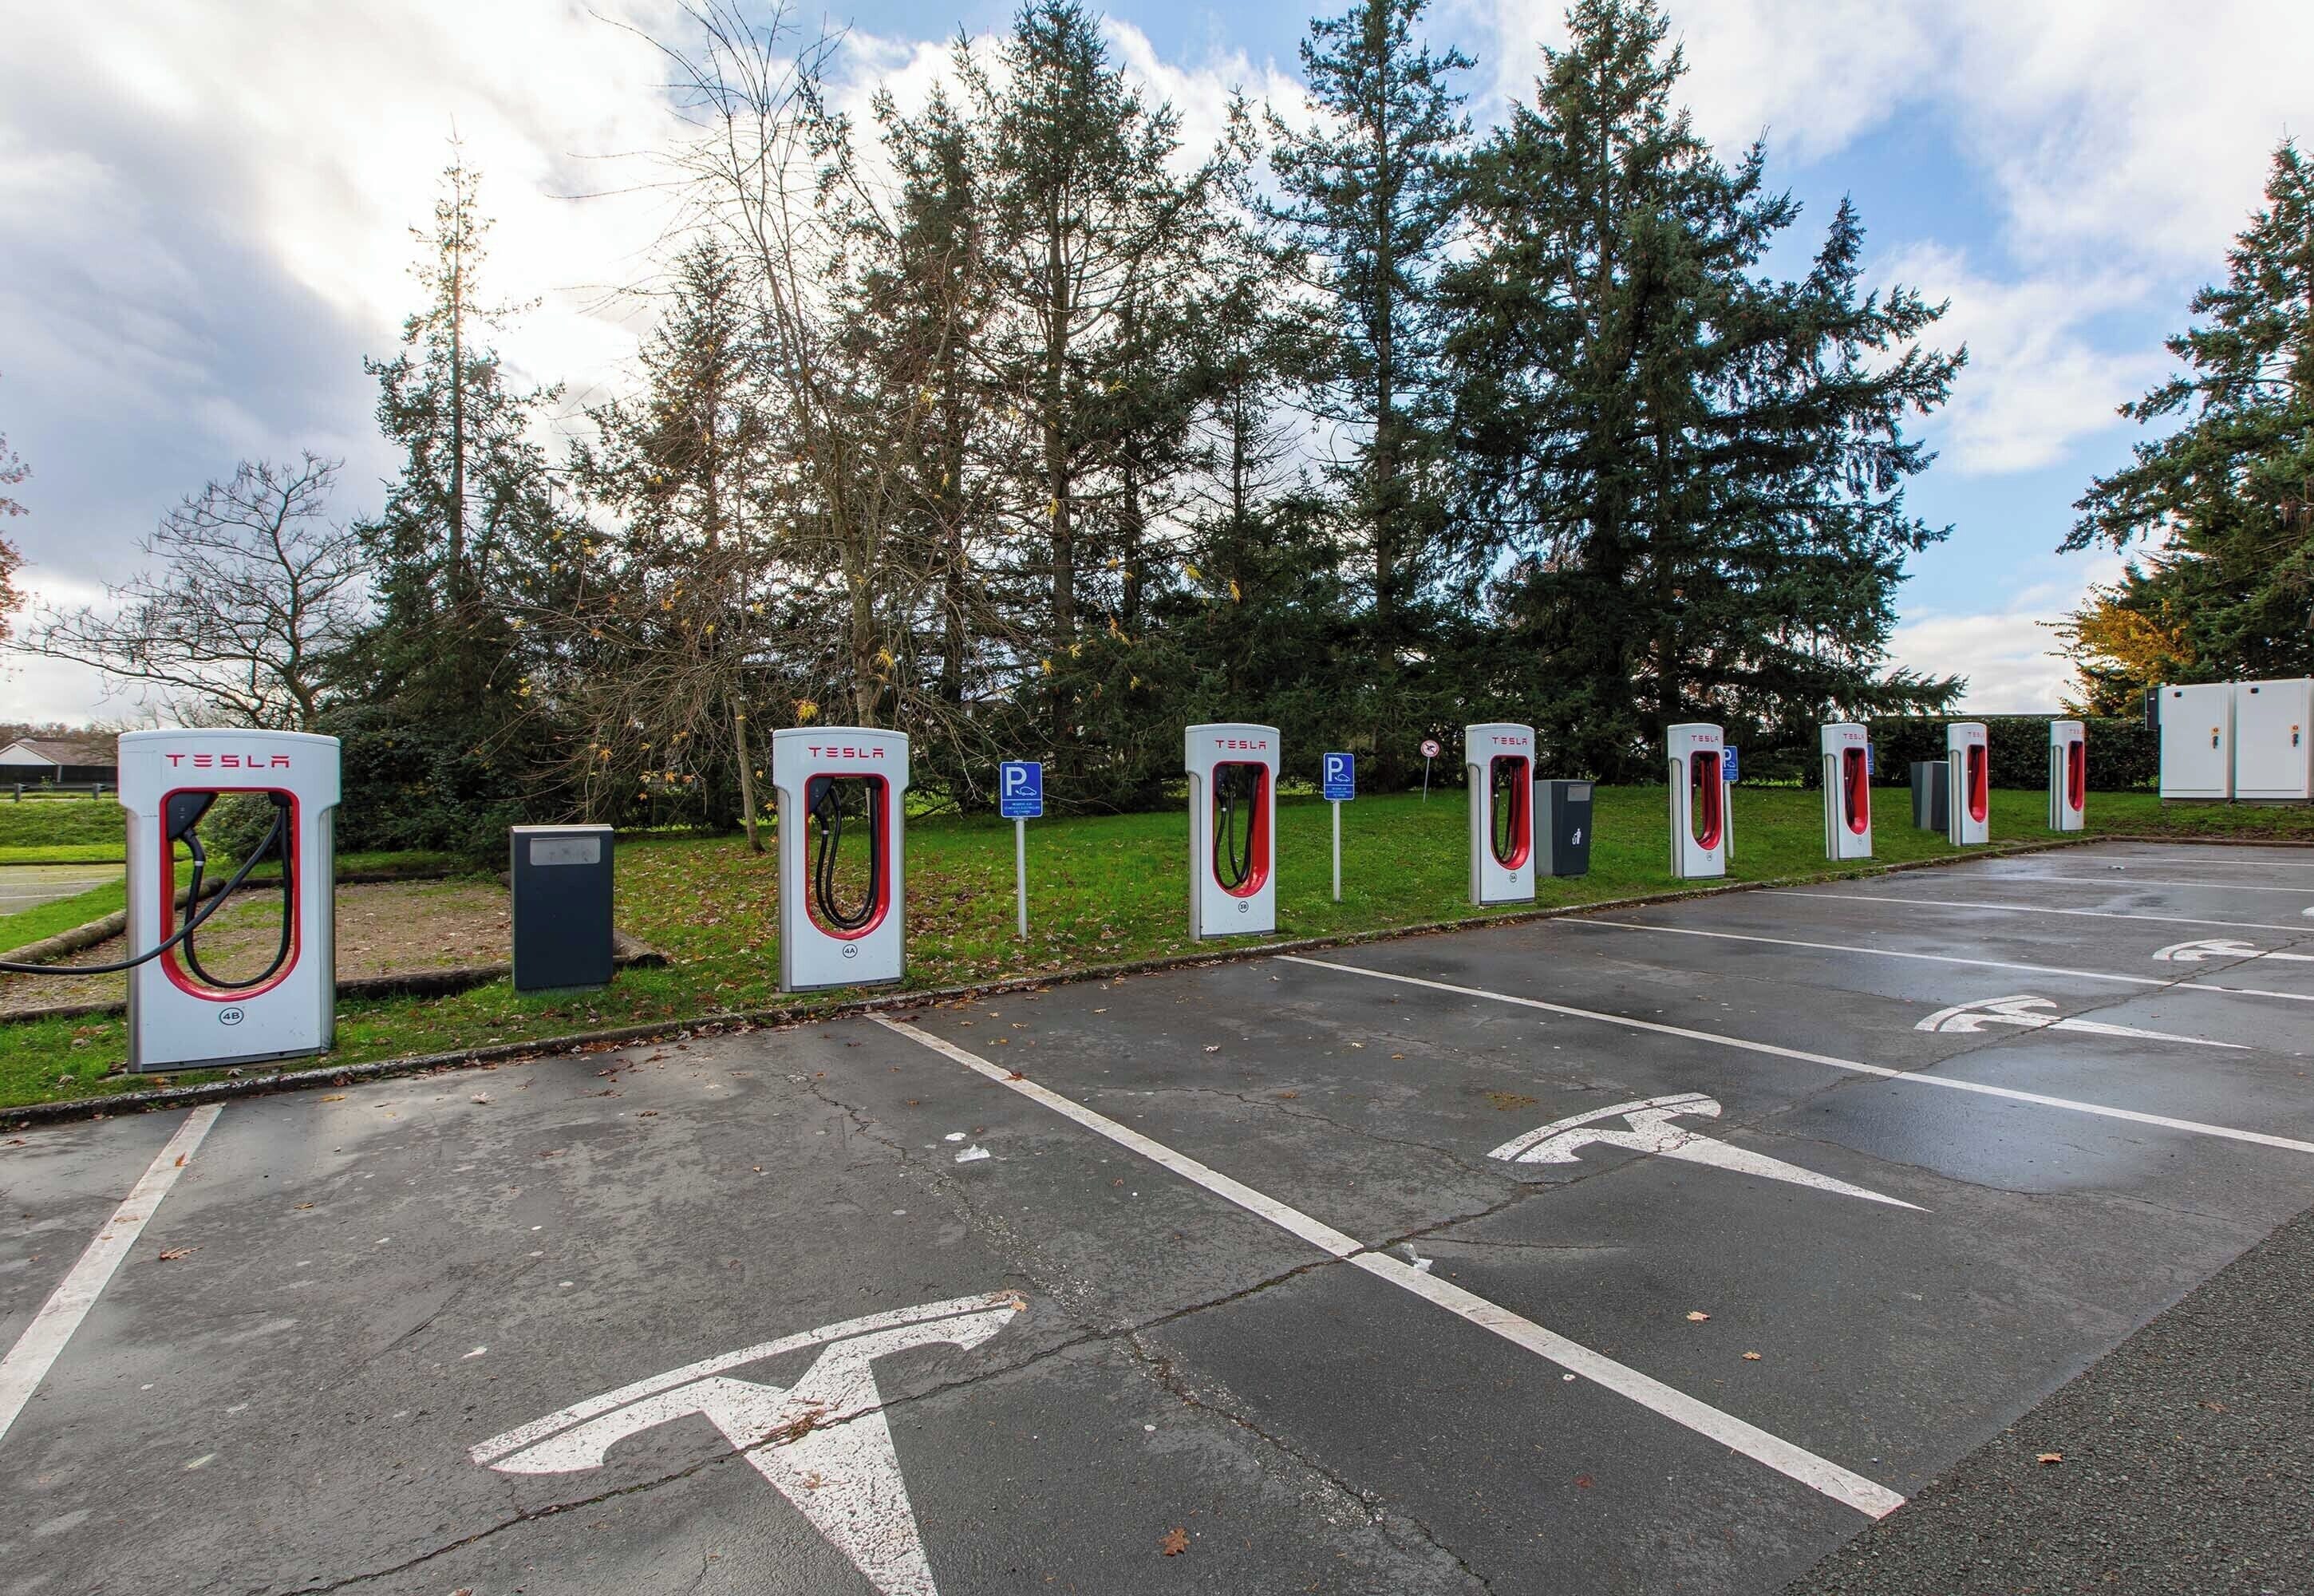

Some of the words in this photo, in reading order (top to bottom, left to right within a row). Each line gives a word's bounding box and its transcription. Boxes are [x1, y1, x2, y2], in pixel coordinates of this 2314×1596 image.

[1215, 740, 1266, 750] TESLA
[808, 747, 884, 758] TESLA
[165, 754, 290, 768] TESLA
[1328, 757, 1344, 782] P
[1006, 766, 1028, 796] P
